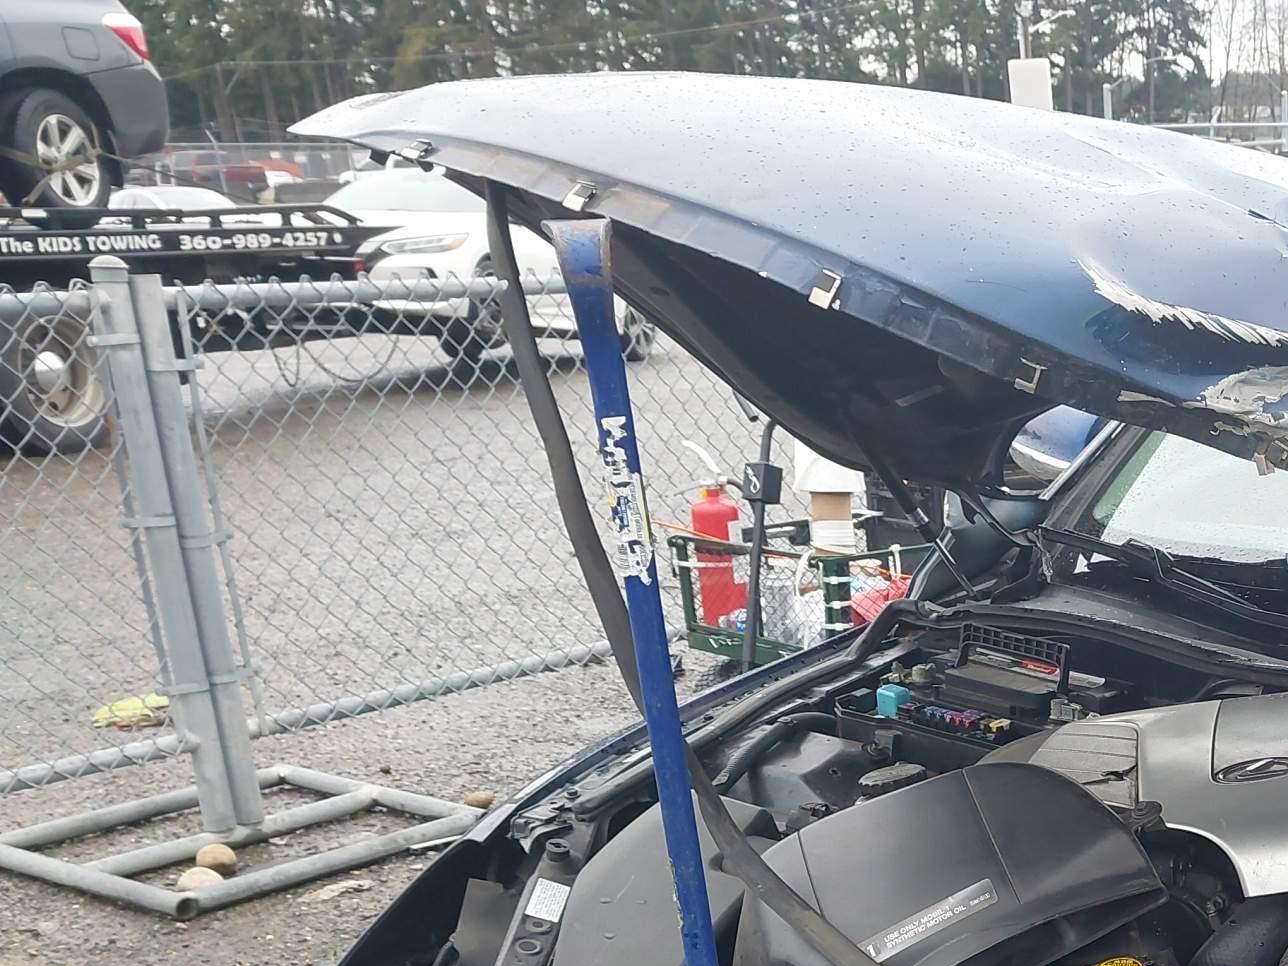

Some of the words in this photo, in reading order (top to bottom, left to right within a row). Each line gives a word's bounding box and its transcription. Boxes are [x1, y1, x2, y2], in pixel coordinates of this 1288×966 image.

[0, 237, 33, 252] The
[37, 235, 82, 252] KIDS
[86, 234, 162, 250] TOWING
[178, 232, 328, 250] 360-989-4257
[884, 929, 900, 943] USE
[900, 920, 919, 934] ONLY
[920, 908, 944, 924] MOBIL
[886, 924, 926, 948] SYNTHETIC
[926, 911, 953, 928] MOTOR
[954, 904, 966, 914] OIL
